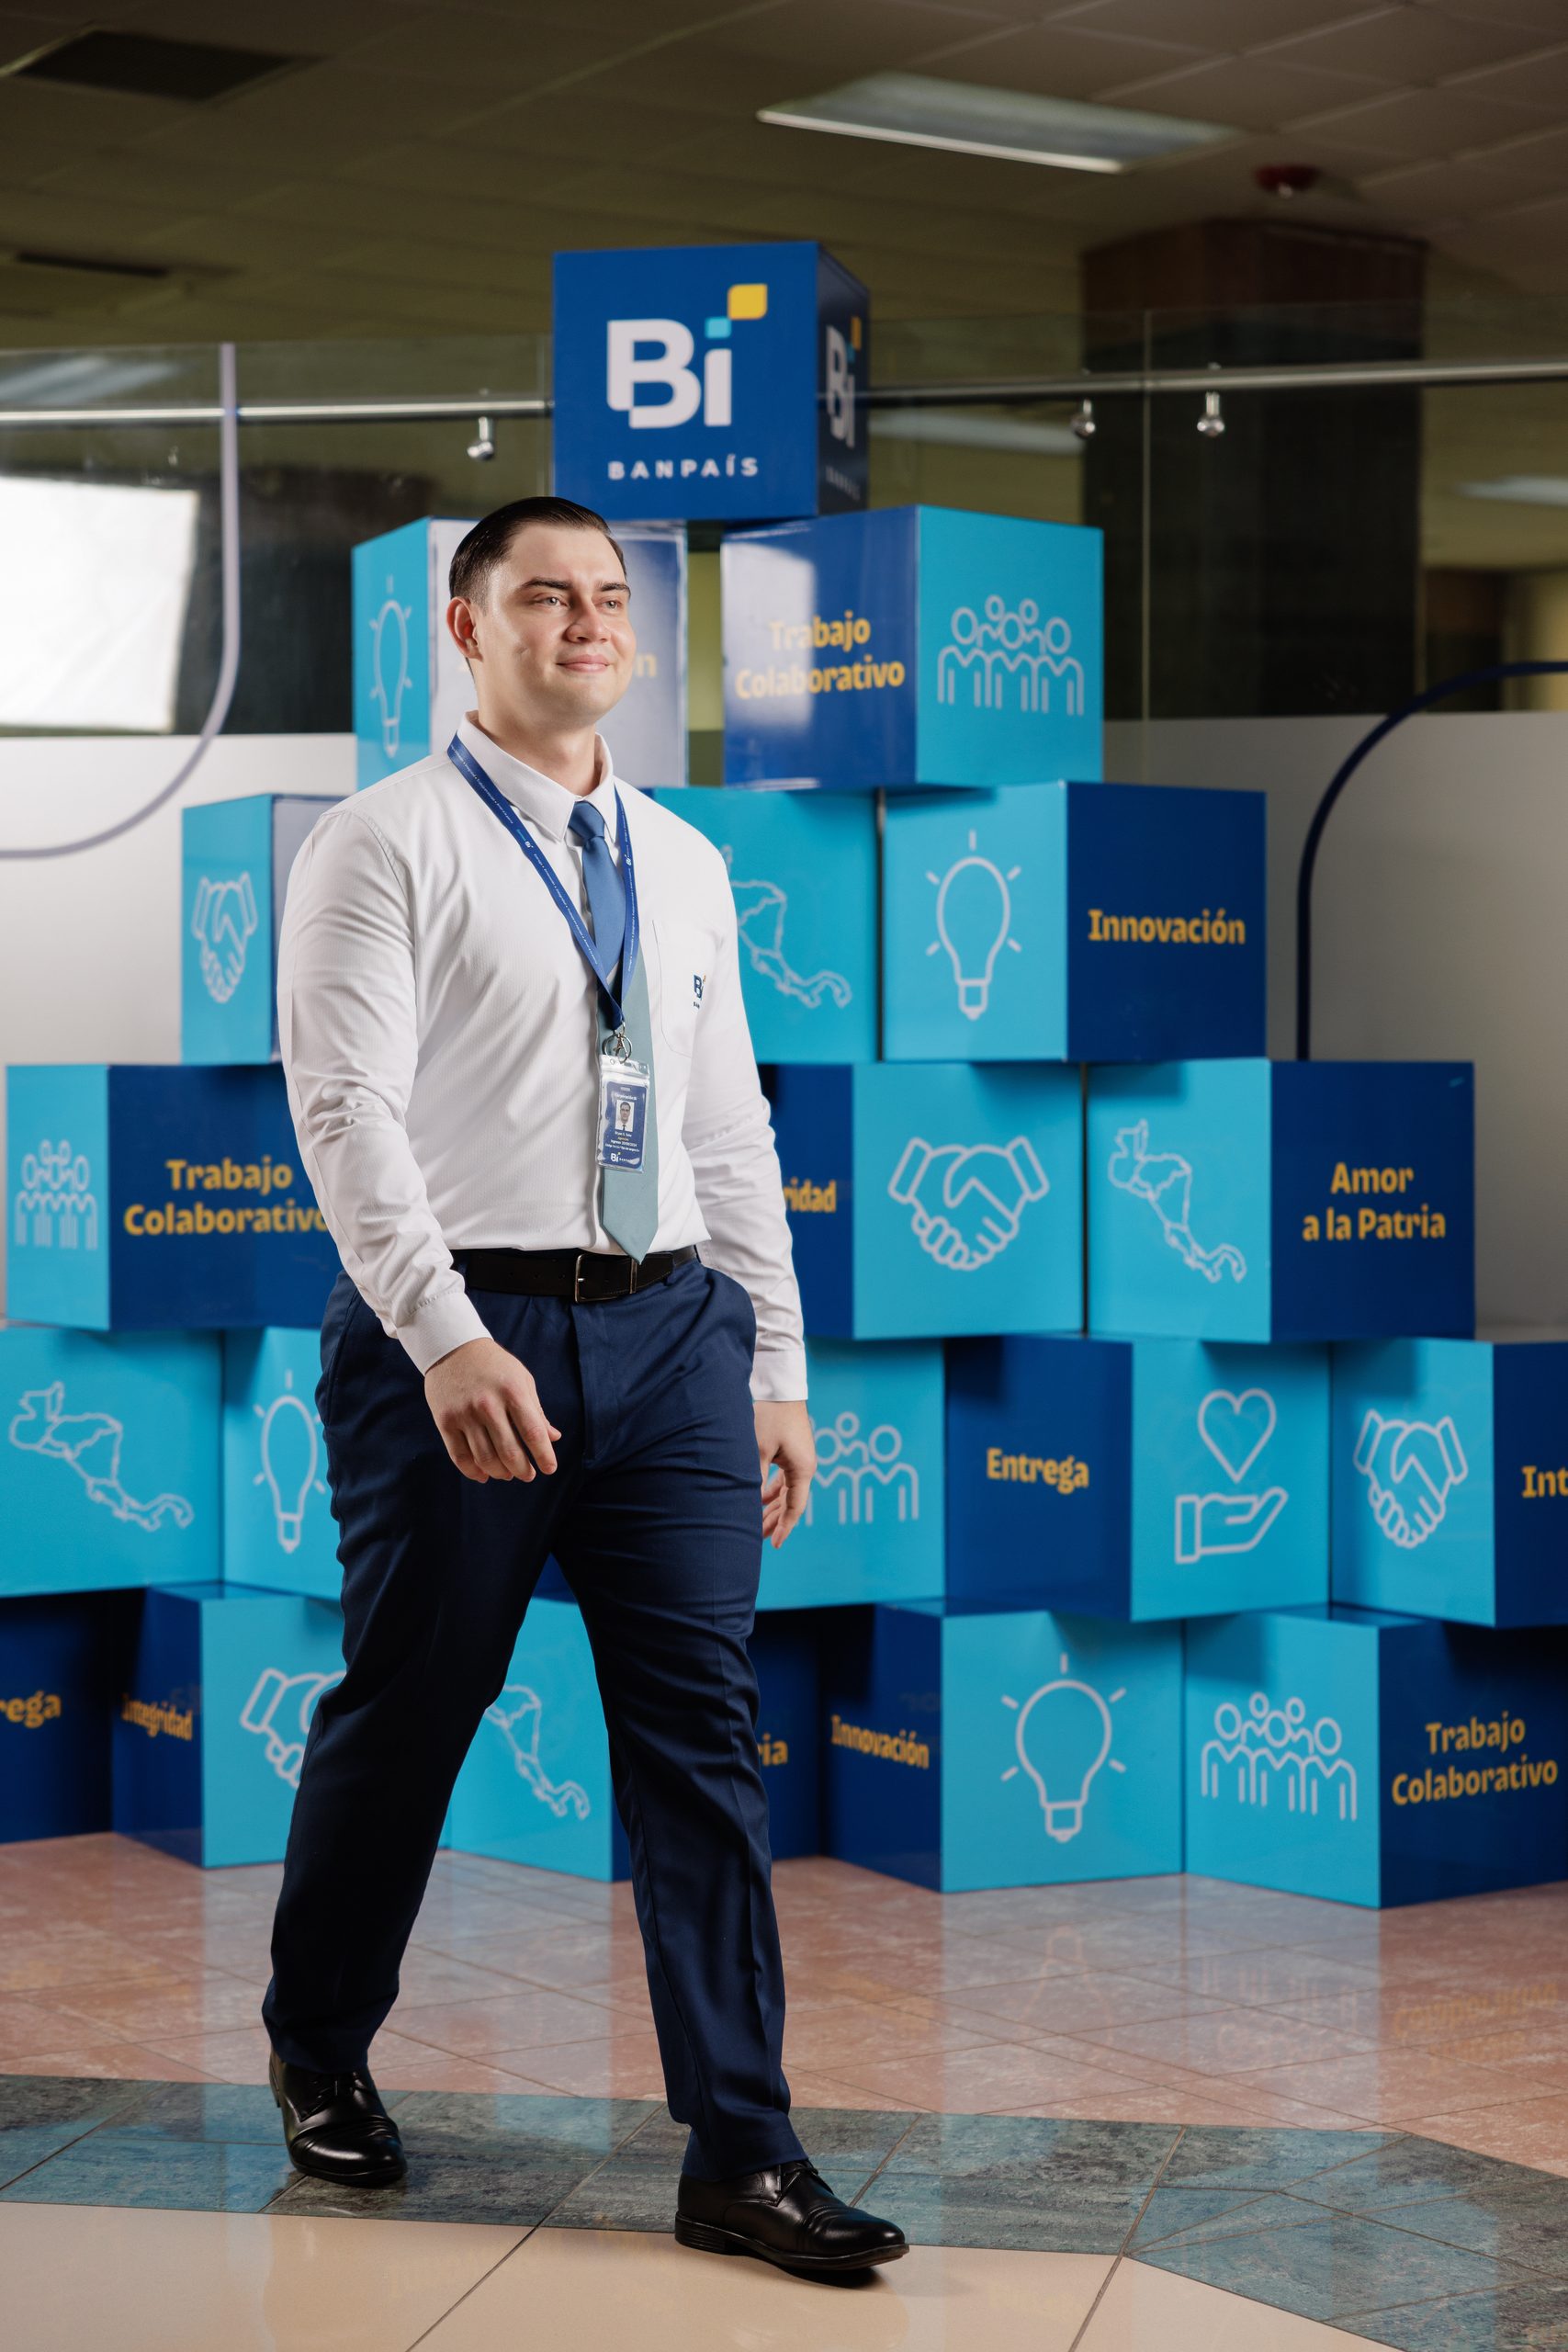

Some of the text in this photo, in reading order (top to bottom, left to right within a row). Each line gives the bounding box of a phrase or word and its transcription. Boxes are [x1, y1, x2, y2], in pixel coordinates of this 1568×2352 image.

[606, 318, 732, 429] Bi
[607, 454, 759, 480] BANPAÍS
[768, 609, 871, 652] Trabajo
[735, 653, 906, 699] Colaborativo
[1088, 908, 1246, 944] Innovación
[165, 1155, 293, 1195] Trabajo
[1330, 1161, 1415, 1194] Amor
[1302, 1203, 1446, 1241] a la Patria
[987, 1447, 1089, 1494] Entrega
[830, 1714, 930, 1770] Innovación
[1425, 1711, 1526, 1755] Trabajo
[1392, 1754, 1559, 1805] Colaborativo
